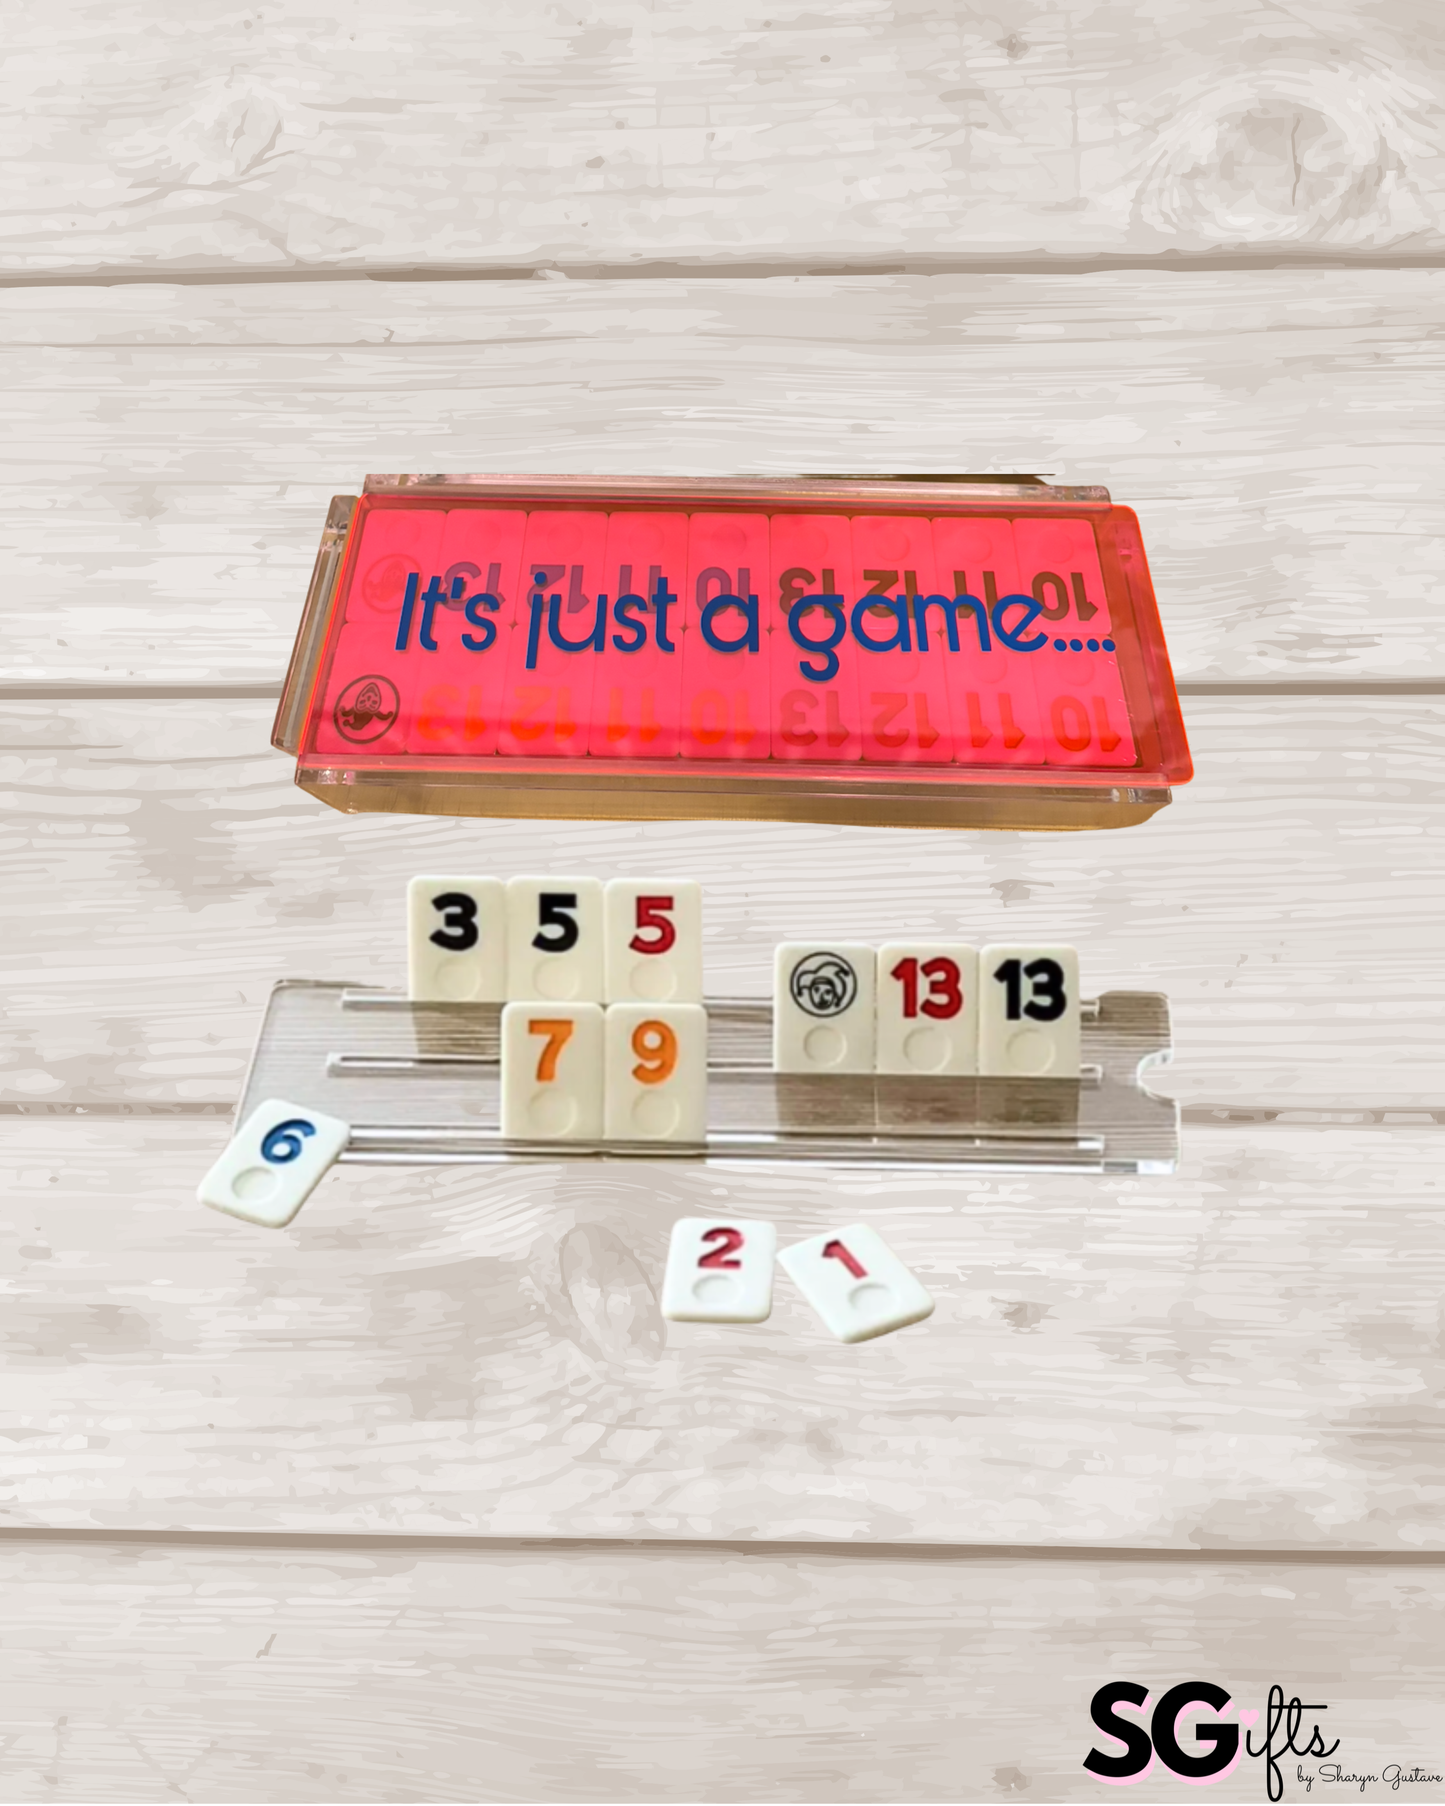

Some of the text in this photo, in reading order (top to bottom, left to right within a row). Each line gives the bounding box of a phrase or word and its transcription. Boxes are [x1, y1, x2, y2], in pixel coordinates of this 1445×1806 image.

[527, 564, 590, 614] 12
[1031, 571, 1099, 622] 10
[395, 571, 1116, 682] It's just a game....
[417, 684, 486, 742] 13
[510, 685, 577, 743] 12
[607, 687, 662, 744] 11
[691, 688, 756, 745] 10
[779, 689, 850, 747] 13
[870, 692, 940, 749] 12
[966, 693, 1026, 749] 11
[1050, 695, 1122, 752] 10
[429, 892, 479, 951] 3
[531, 893, 579, 953] 5
[628, 896, 676, 954] 5
[891, 956, 963, 1020] 13
[993, 958, 1067, 1022] 13
[527, 1019, 574, 1082] 7
[631, 1020, 678, 1085] 9
[260, 1118, 317, 1164] 6
[697, 1227, 745, 1270] 2
[821, 1239, 868, 1280] 1
